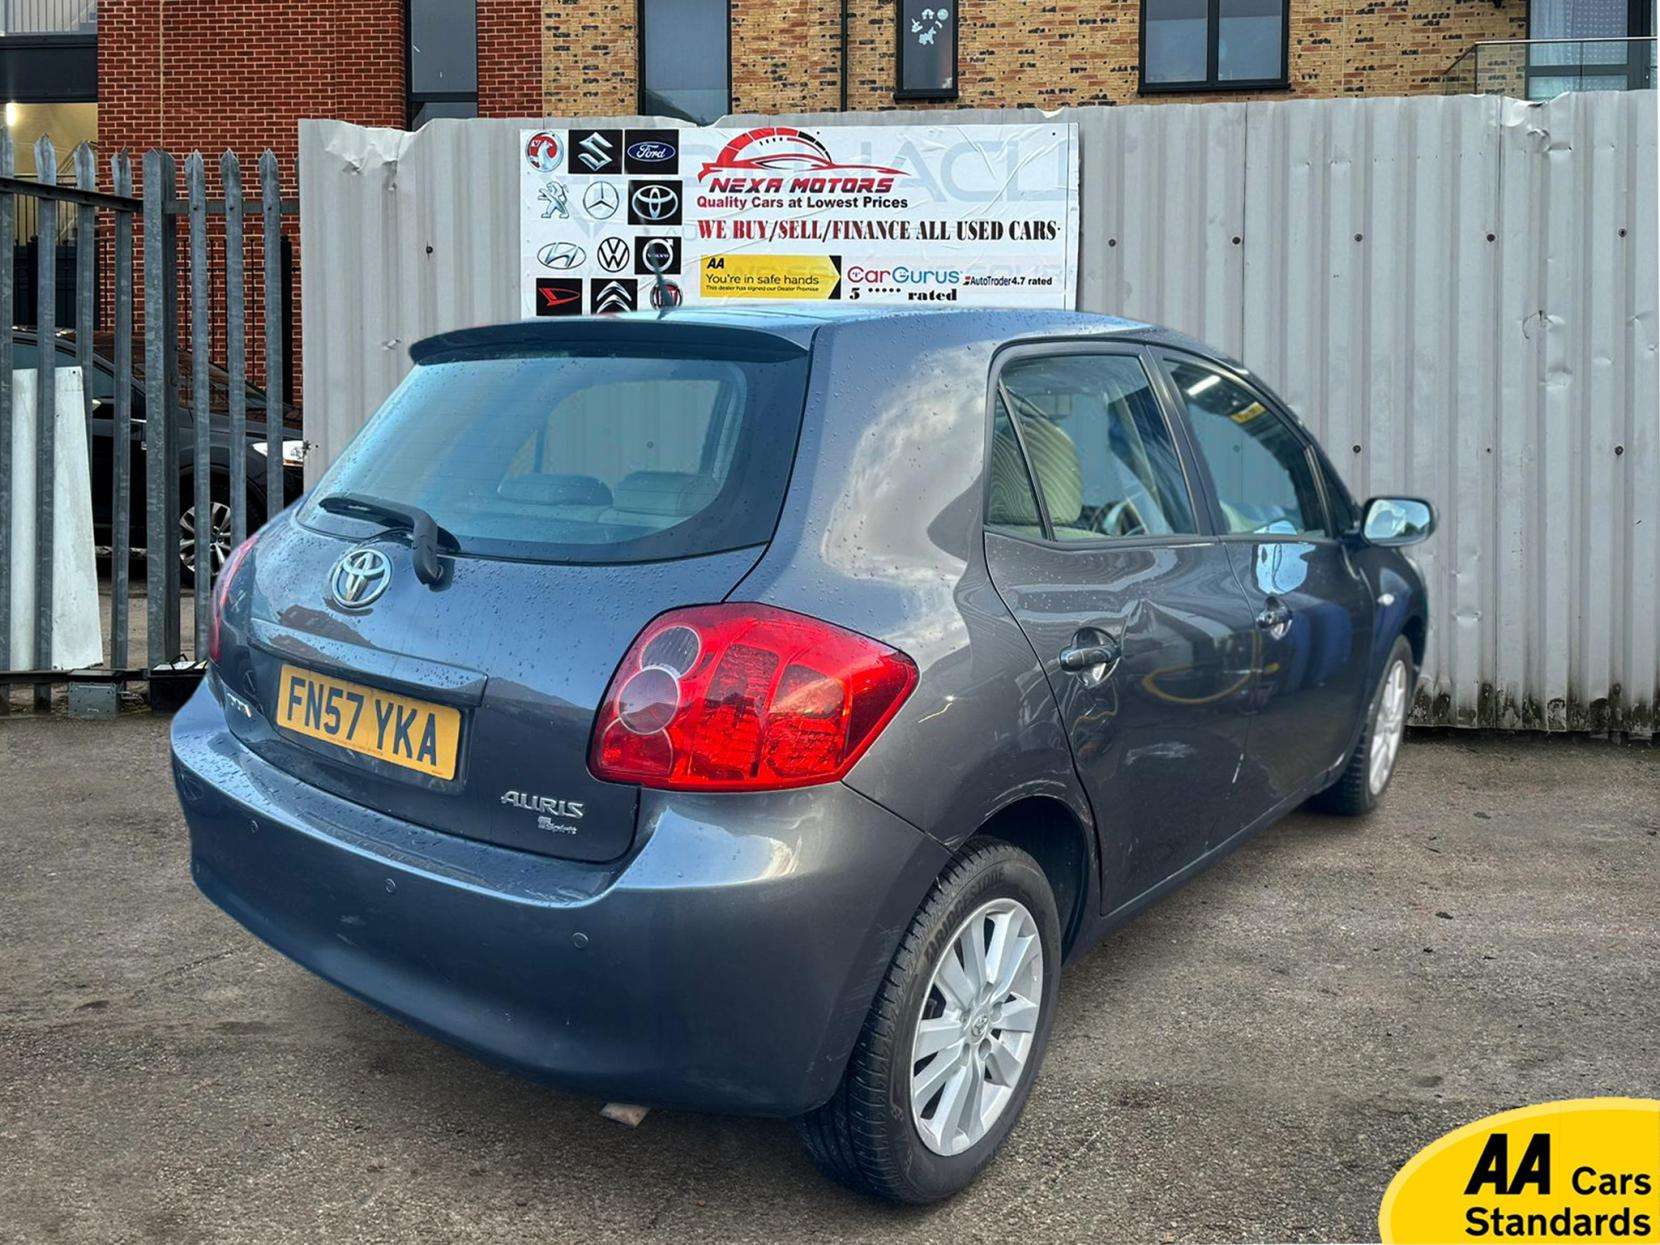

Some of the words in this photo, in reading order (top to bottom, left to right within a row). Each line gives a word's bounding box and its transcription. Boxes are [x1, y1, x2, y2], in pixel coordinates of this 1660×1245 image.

[636, 144, 666, 158] Ford
[708, 178, 784, 193] NEXA
[789, 178, 895, 193] MOTORS
[697, 196, 747, 210] Quality
[752, 196, 784, 208] Cars
[788, 196, 803, 208] at
[807, 196, 859, 208] Lowest
[863, 196, 908, 208] Prices
[697, 220, 727, 240] WE
[916, 220, 950, 240] ALL
[956, 220, 1003, 240] USED
[1008, 220, 1057, 240] CARS
[706, 257, 725, 269] AA
[706, 274, 741, 284] You're
[744, 274, 754, 284] in
[757, 274, 781, 284] safe
[784, 275, 819, 285] hands
[847, 266, 960, 284] CarGurus
[1028, 277, 1052, 285] rated
[849, 288, 860, 300] 5
[908, 288, 957, 301] rated
[287, 675, 365, 741] FN57
[374, 699, 438, 767] YKA
[501, 791, 584, 818] AURIS
